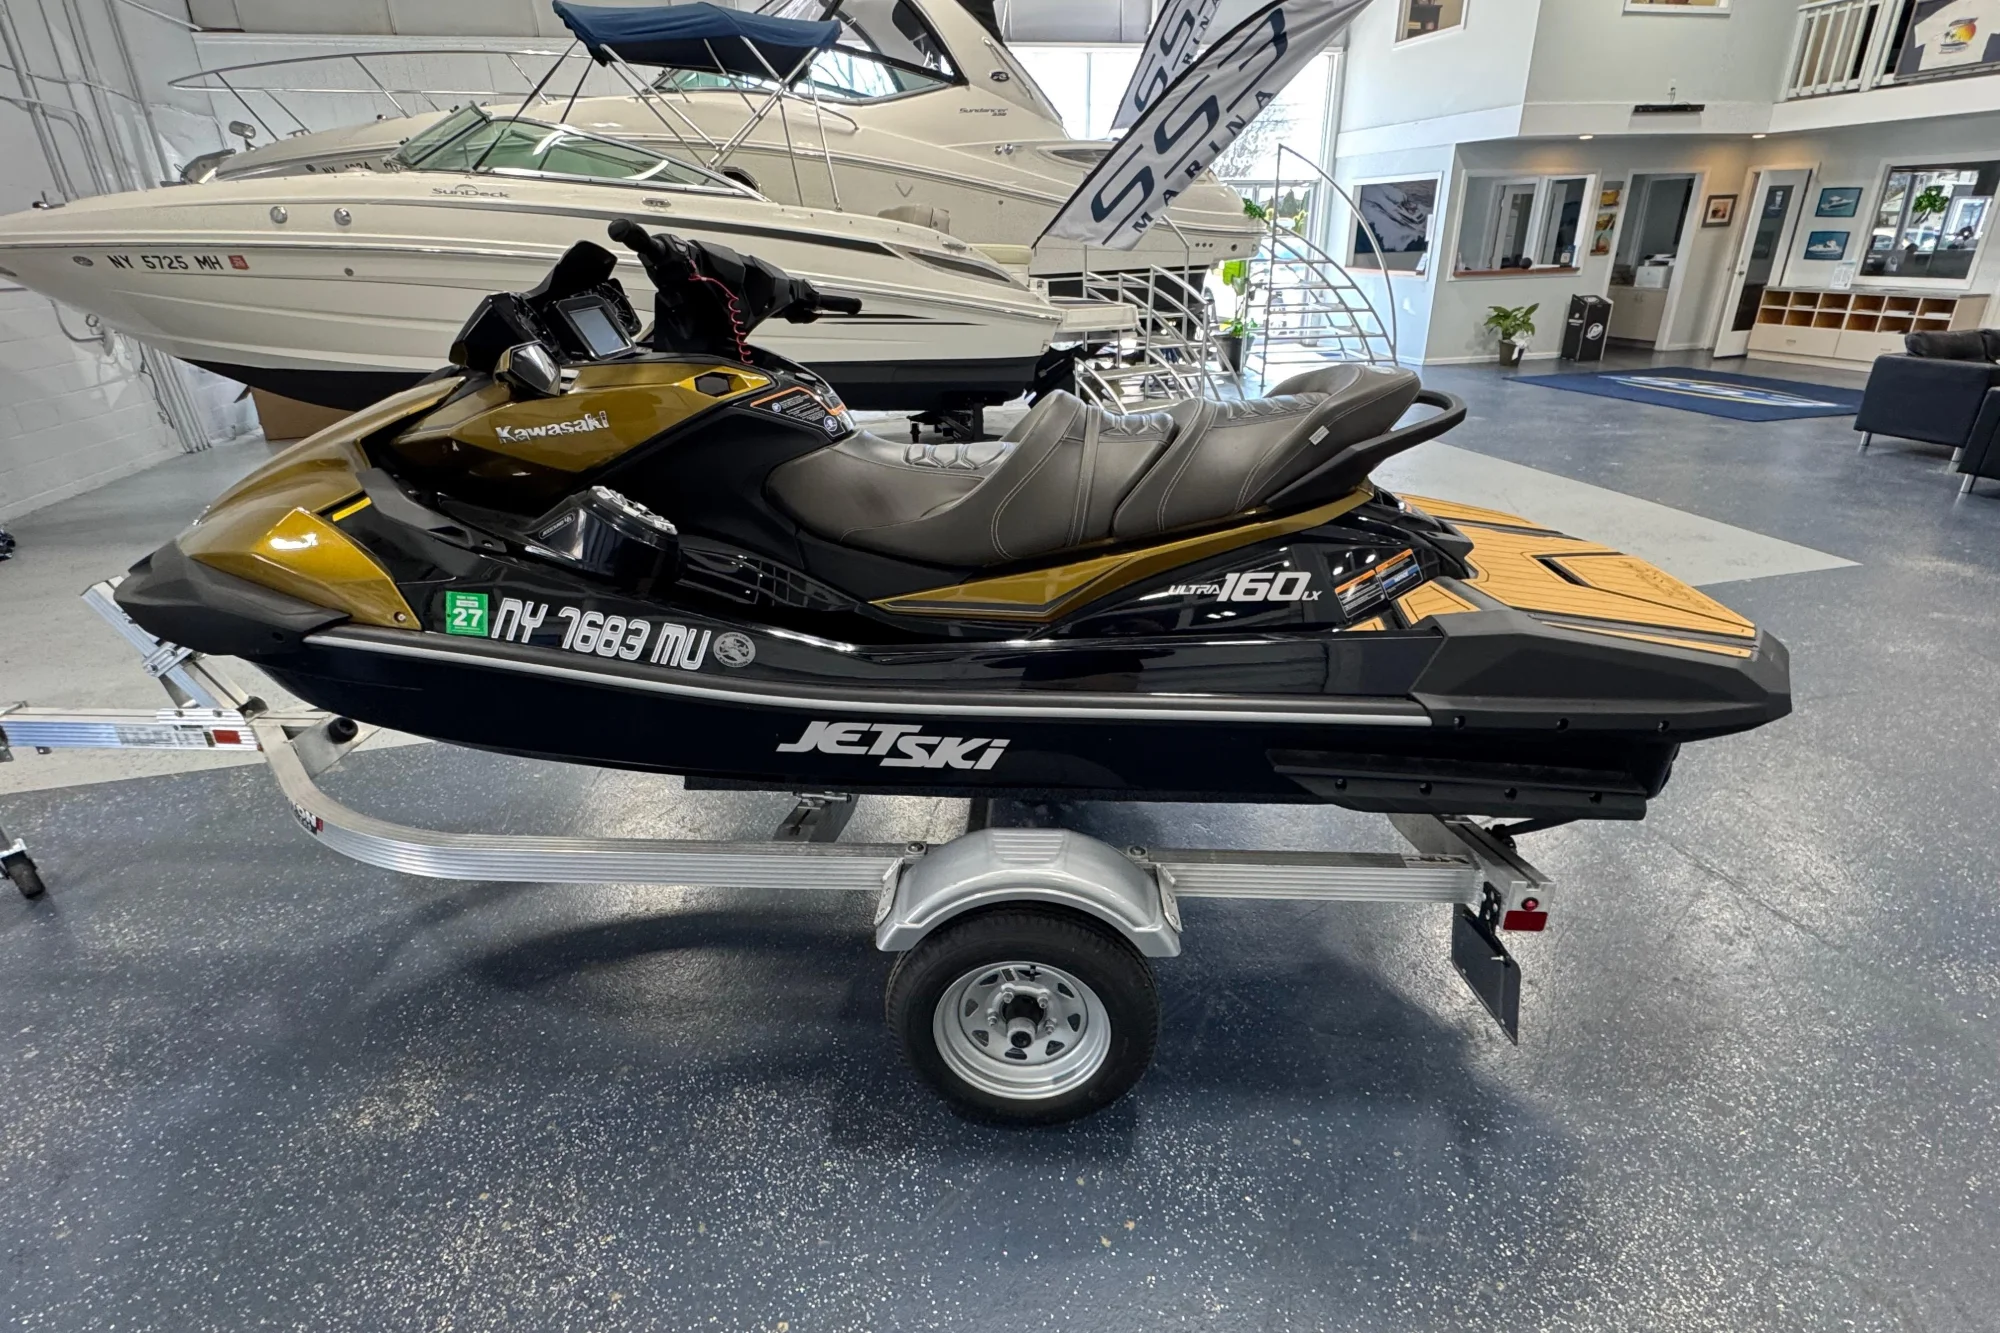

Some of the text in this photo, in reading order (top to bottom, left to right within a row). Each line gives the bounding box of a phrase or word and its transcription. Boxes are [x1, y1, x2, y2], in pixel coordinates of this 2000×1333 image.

[1132, 89, 1274, 233] MARINA
[432, 187, 510, 198] SunDeck
[107, 255, 134, 269] NY
[140, 255, 189, 270] 5725
[194, 255, 224, 270] MH
[495, 410, 609, 444] Kawasaki
[1168, 572, 1323, 602] ULTRA 160 LX
[452, 607, 484, 628] 27
[491, 597, 712, 671] NY 7683 MU
